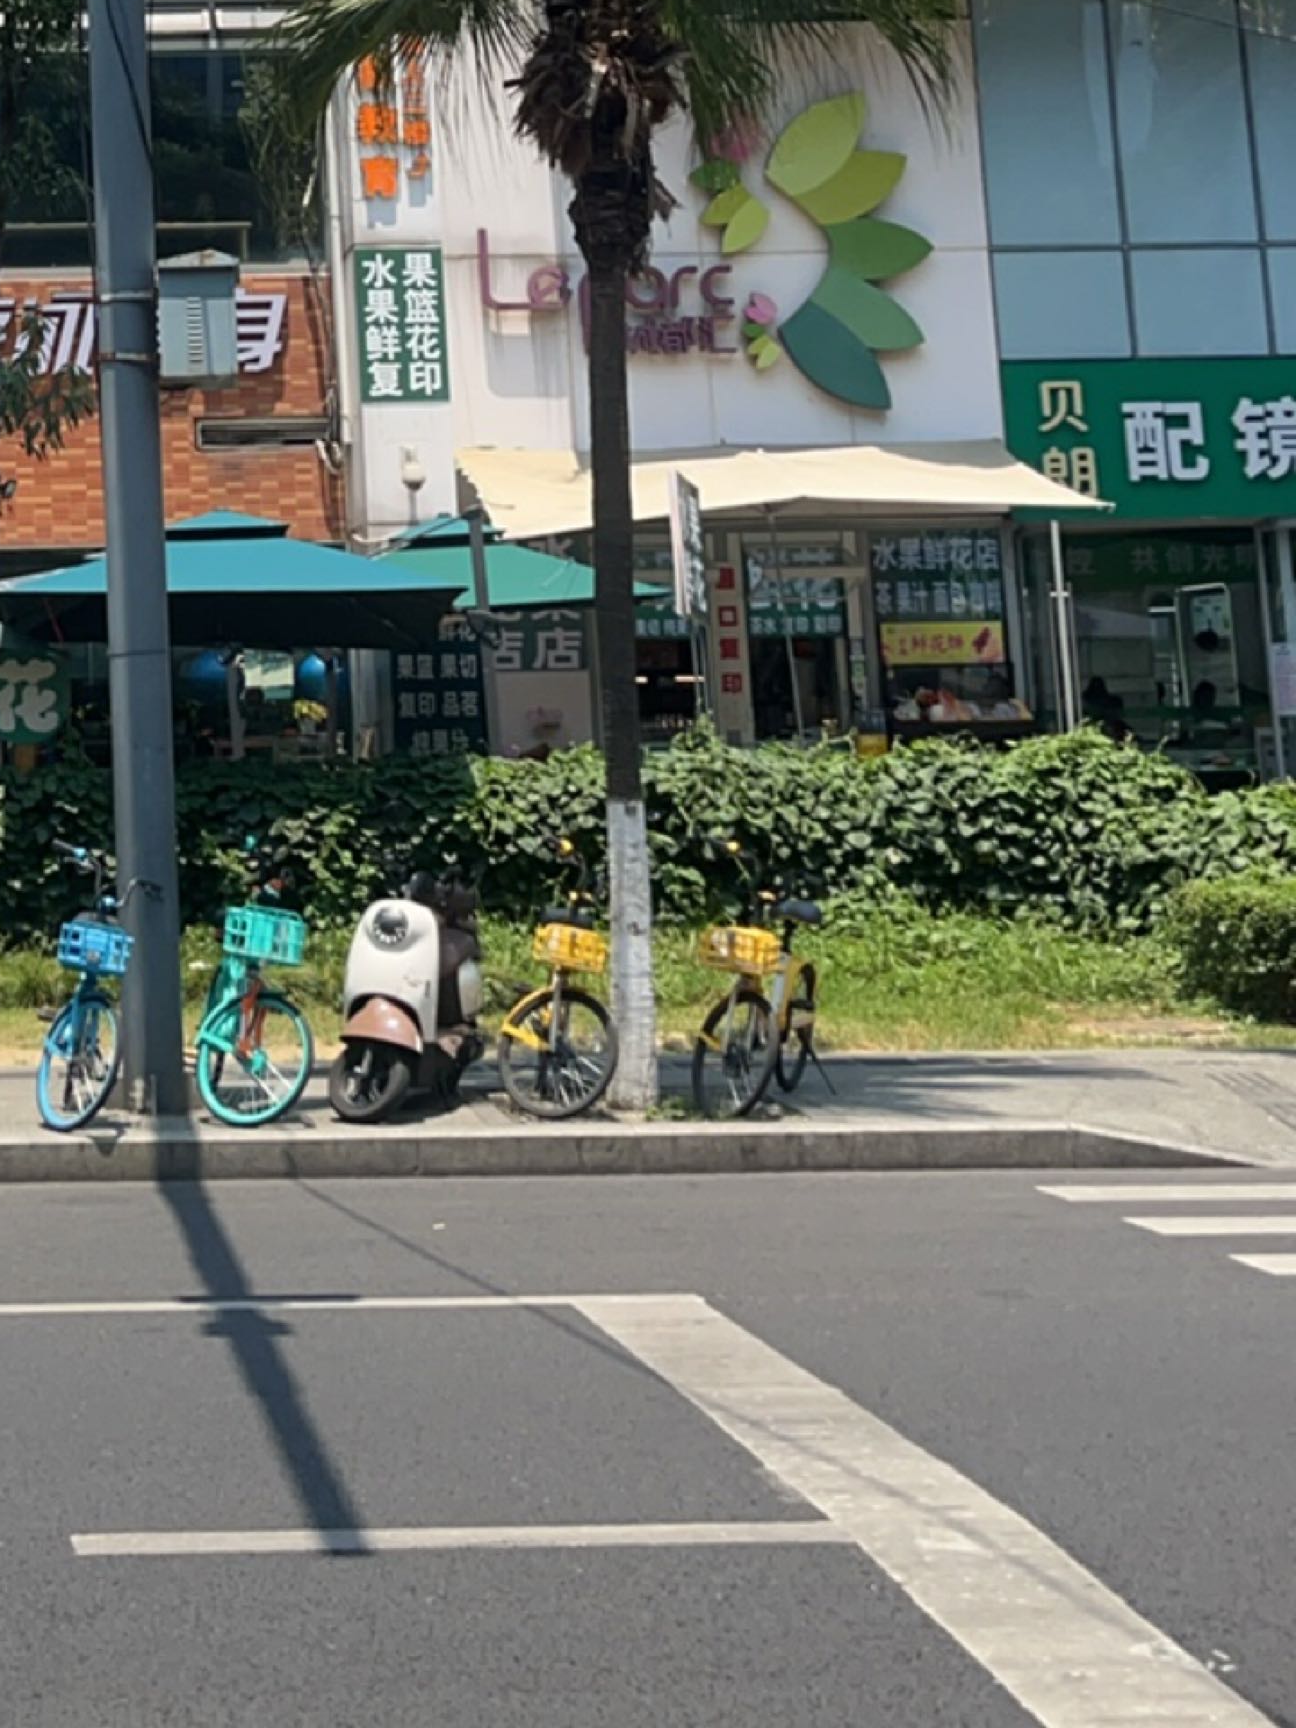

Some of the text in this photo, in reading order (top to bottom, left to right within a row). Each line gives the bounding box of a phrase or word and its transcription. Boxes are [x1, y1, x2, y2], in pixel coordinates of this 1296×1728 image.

[361, 252, 438, 288] 水果
[364, 288, 440, 323] 果篮
[365, 323, 442, 360] 鲜花
[368, 361, 442, 397] 复印
[1121, 395, 1296, 483] 配镜
[872, 537, 1000, 571] 水果鲜花店
